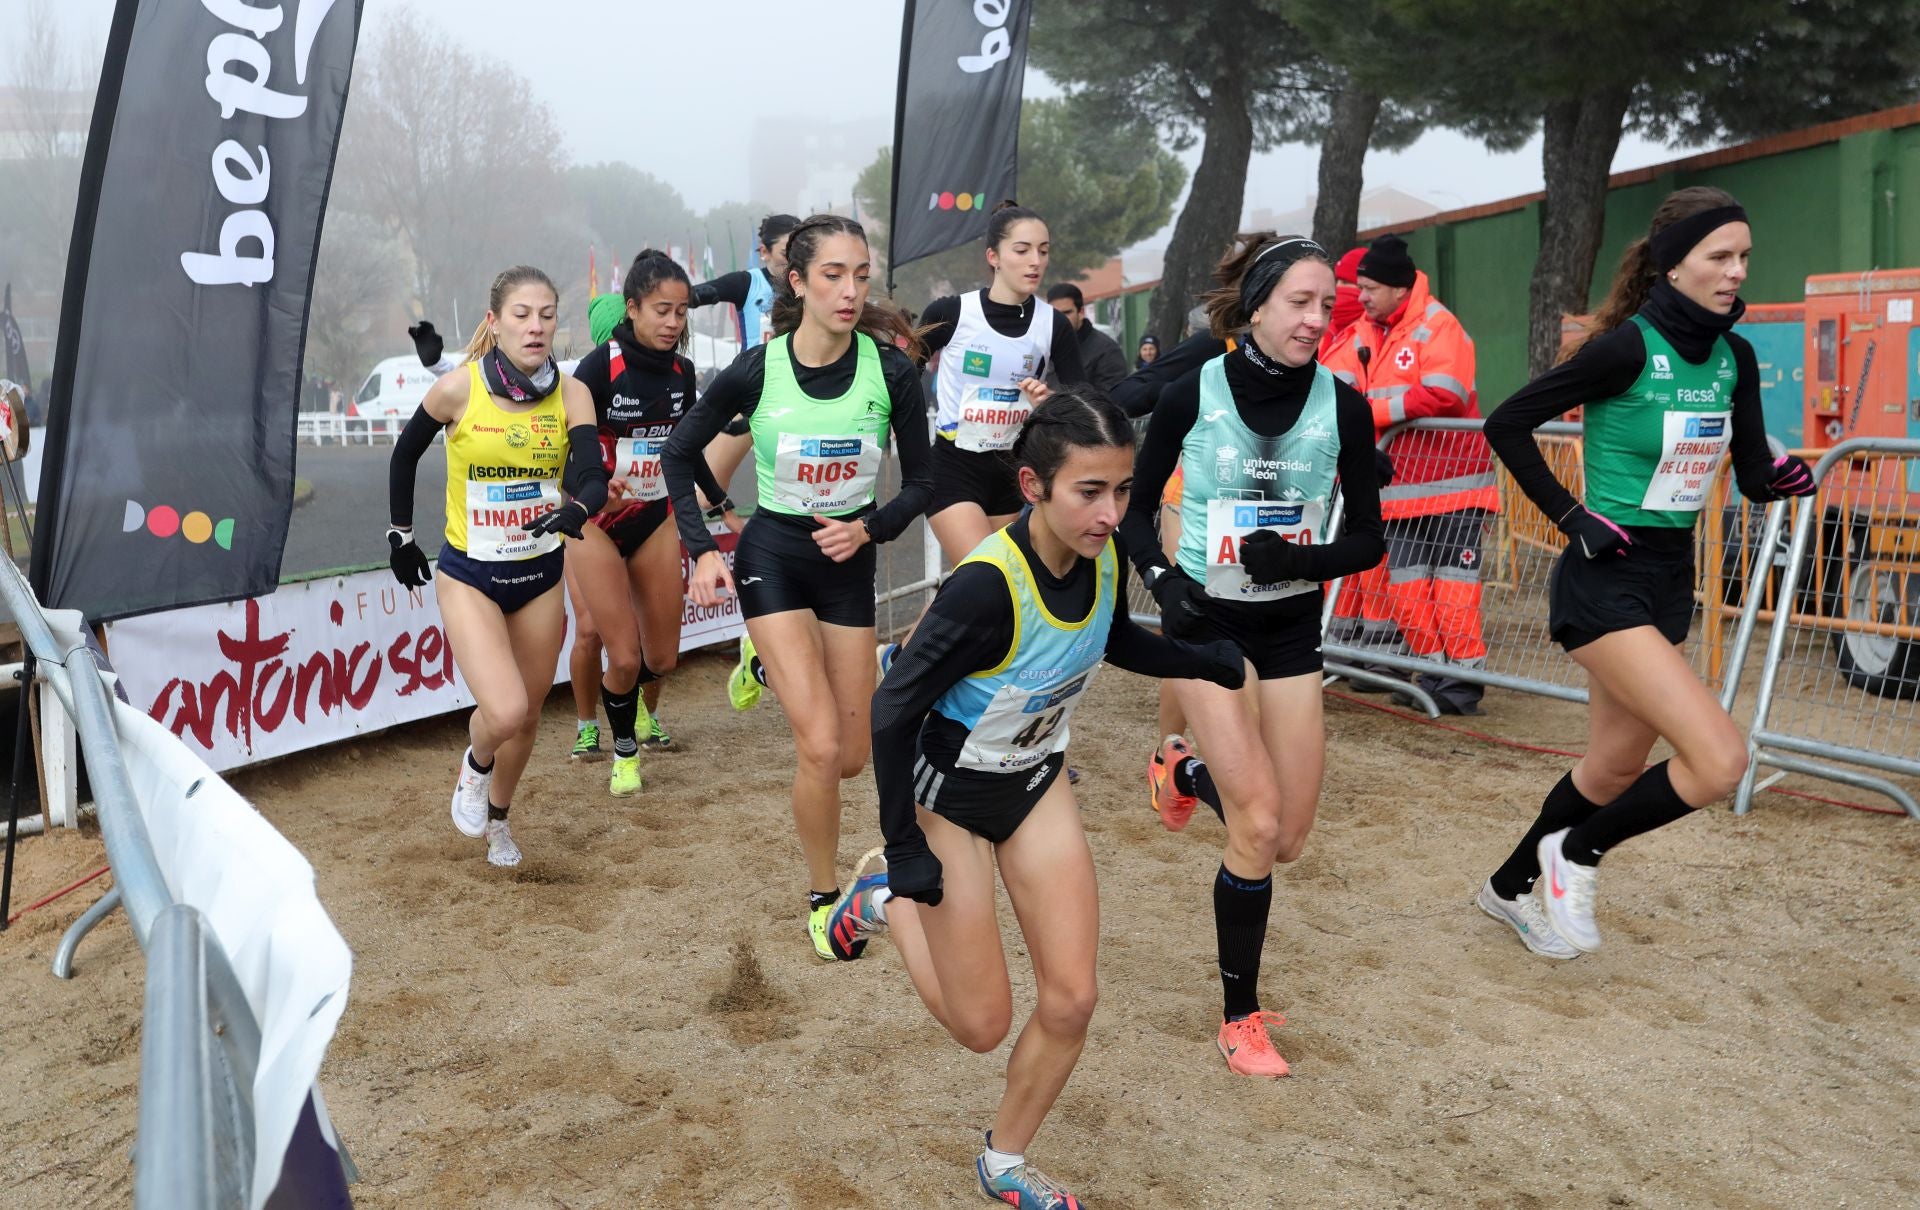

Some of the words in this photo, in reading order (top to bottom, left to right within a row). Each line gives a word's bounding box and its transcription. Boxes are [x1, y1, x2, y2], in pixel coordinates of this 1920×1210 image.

[957, 0, 1011, 73] be
[181, 139, 275, 287] be
[821, 441, 854, 449] Diputación
[1243, 457, 1312, 472] universidad
[1660, 462, 1674, 473] DE
[1675, 461, 1688, 473] LA
[797, 461, 859, 484] RIOS
[1252, 467, 1277, 480] león
[819, 488, 831, 497] 39
[812, 500, 847, 509] CEREALTO
[1258, 509, 1296, 517] Diputación
[1269, 515, 1301, 523] PALENCIA
[506, 533, 527, 542] 1008
[506, 544, 538, 553] CEREALTO
[1011, 707, 1066, 748] 42
[1011, 749, 1049, 767] CEREALTO
